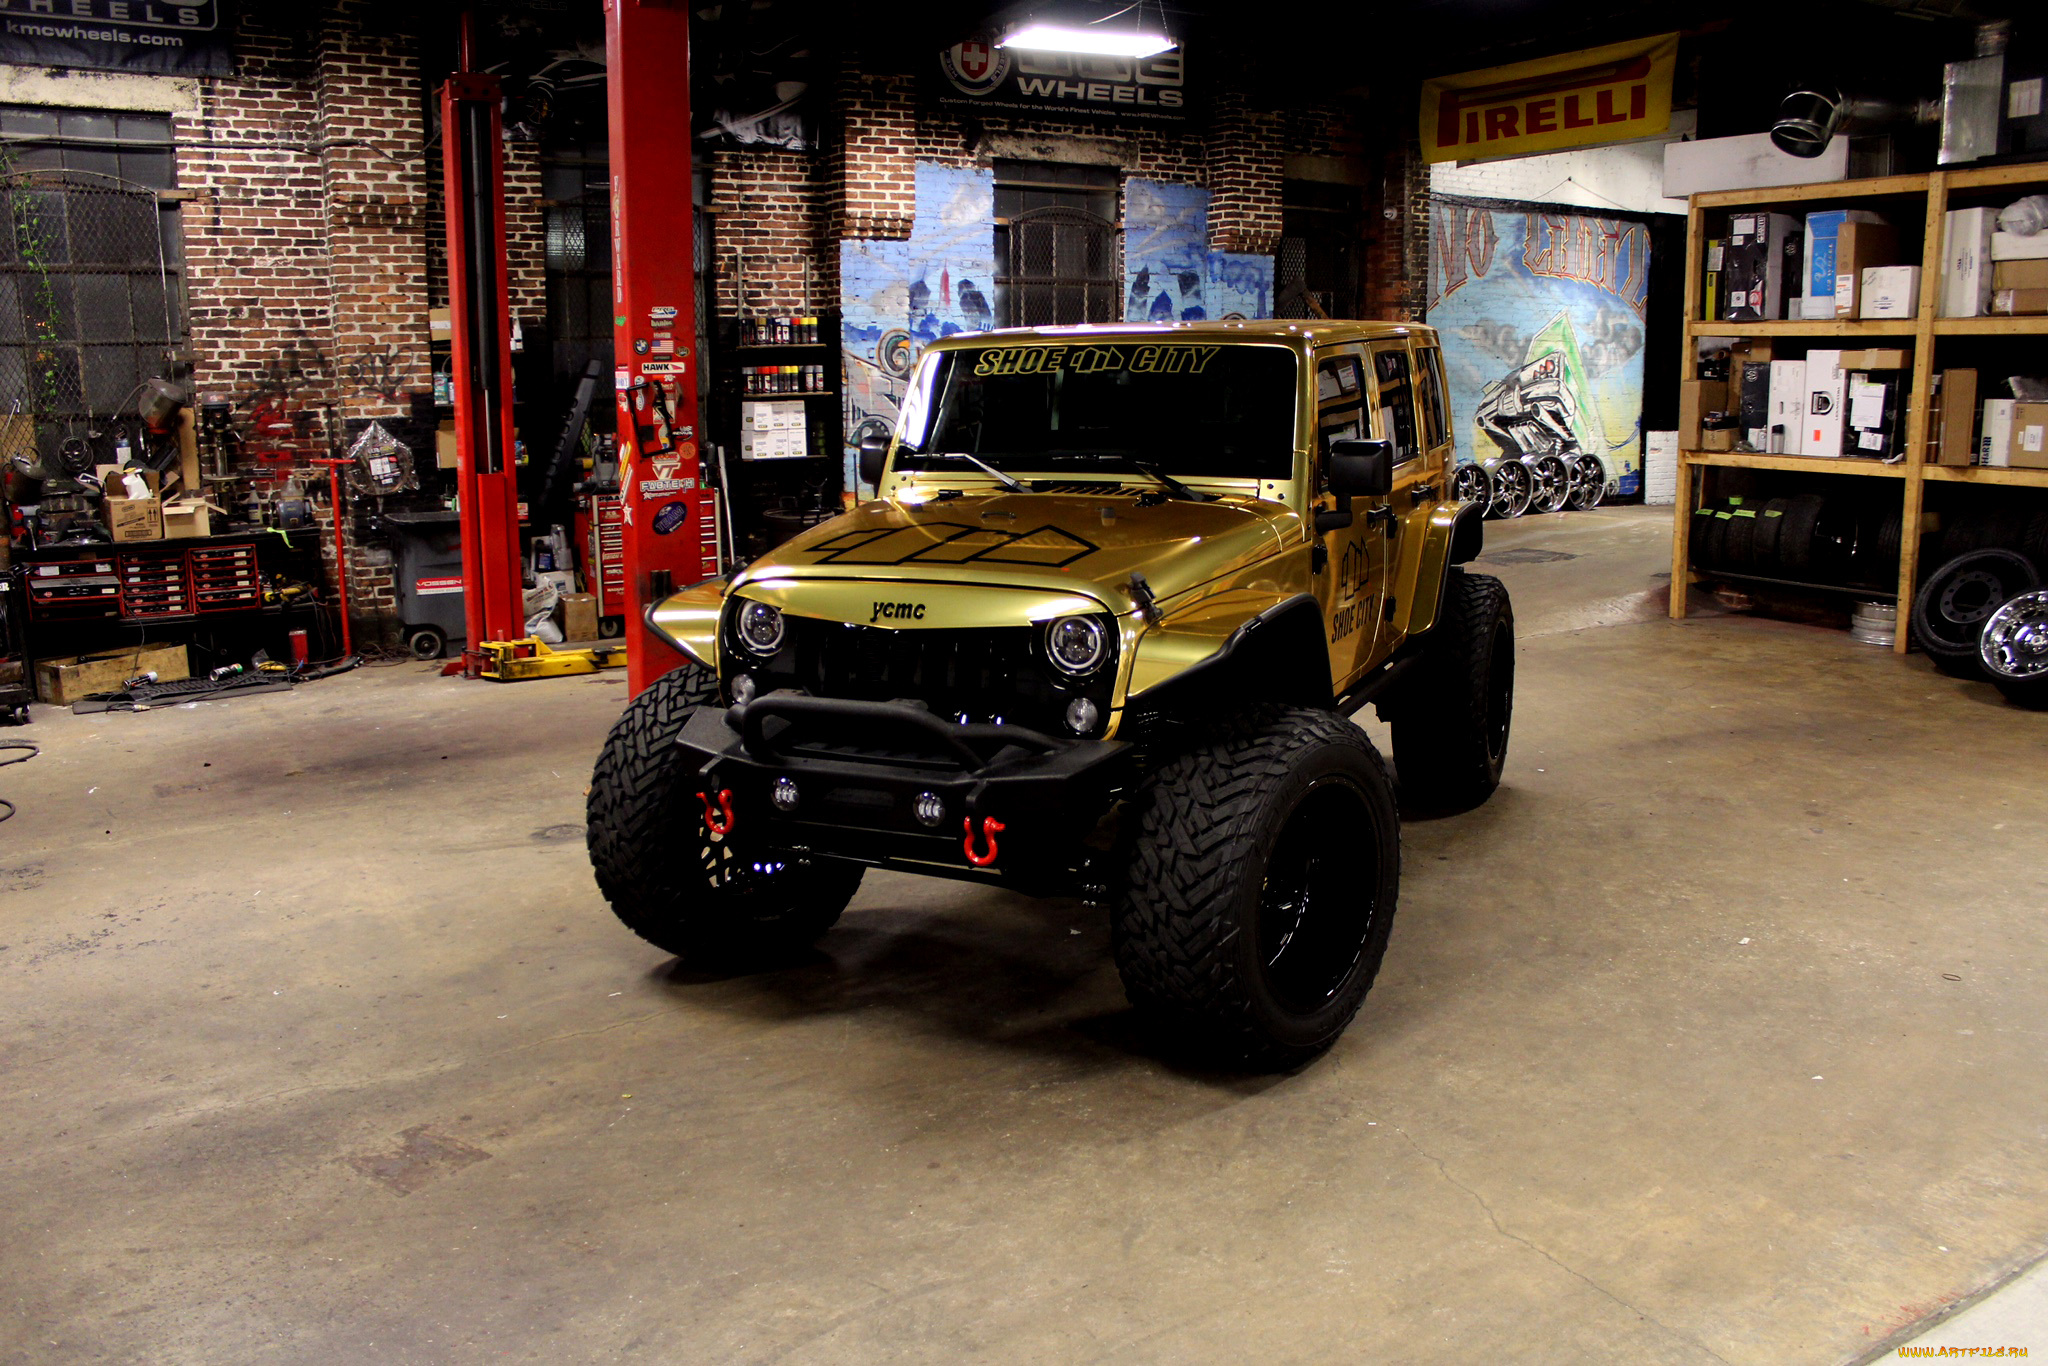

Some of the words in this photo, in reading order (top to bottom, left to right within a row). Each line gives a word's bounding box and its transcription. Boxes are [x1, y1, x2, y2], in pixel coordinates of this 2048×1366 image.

[0, 0, 200, 26] HEELS
[7, 20, 183, 47] kmcwheels.com
[940, 96, 968, 105] Custom
[968, 99, 993, 108] Forged
[994, 101, 1018, 109] Wheels
[1044, 105, 1069, 113] World's
[1069, 106, 1090, 114] Finest
[1017, 76, 1184, 108] WHEELS
[1437, 54, 1651, 148] PIRELLI
[1426, 207, 1500, 313] NO
[643, 363, 670, 372] HAWK
[974, 346, 1069, 377] SHOE
[1129, 346, 1221, 374] CITY
[640, 478, 695, 493] FABTECH
[416, 578, 463, 587] VOSSEN
[870, 602, 926, 623] ycmc
[1331, 604, 1356, 644] SHOE
[1356, 593, 1375, 630] CITY
